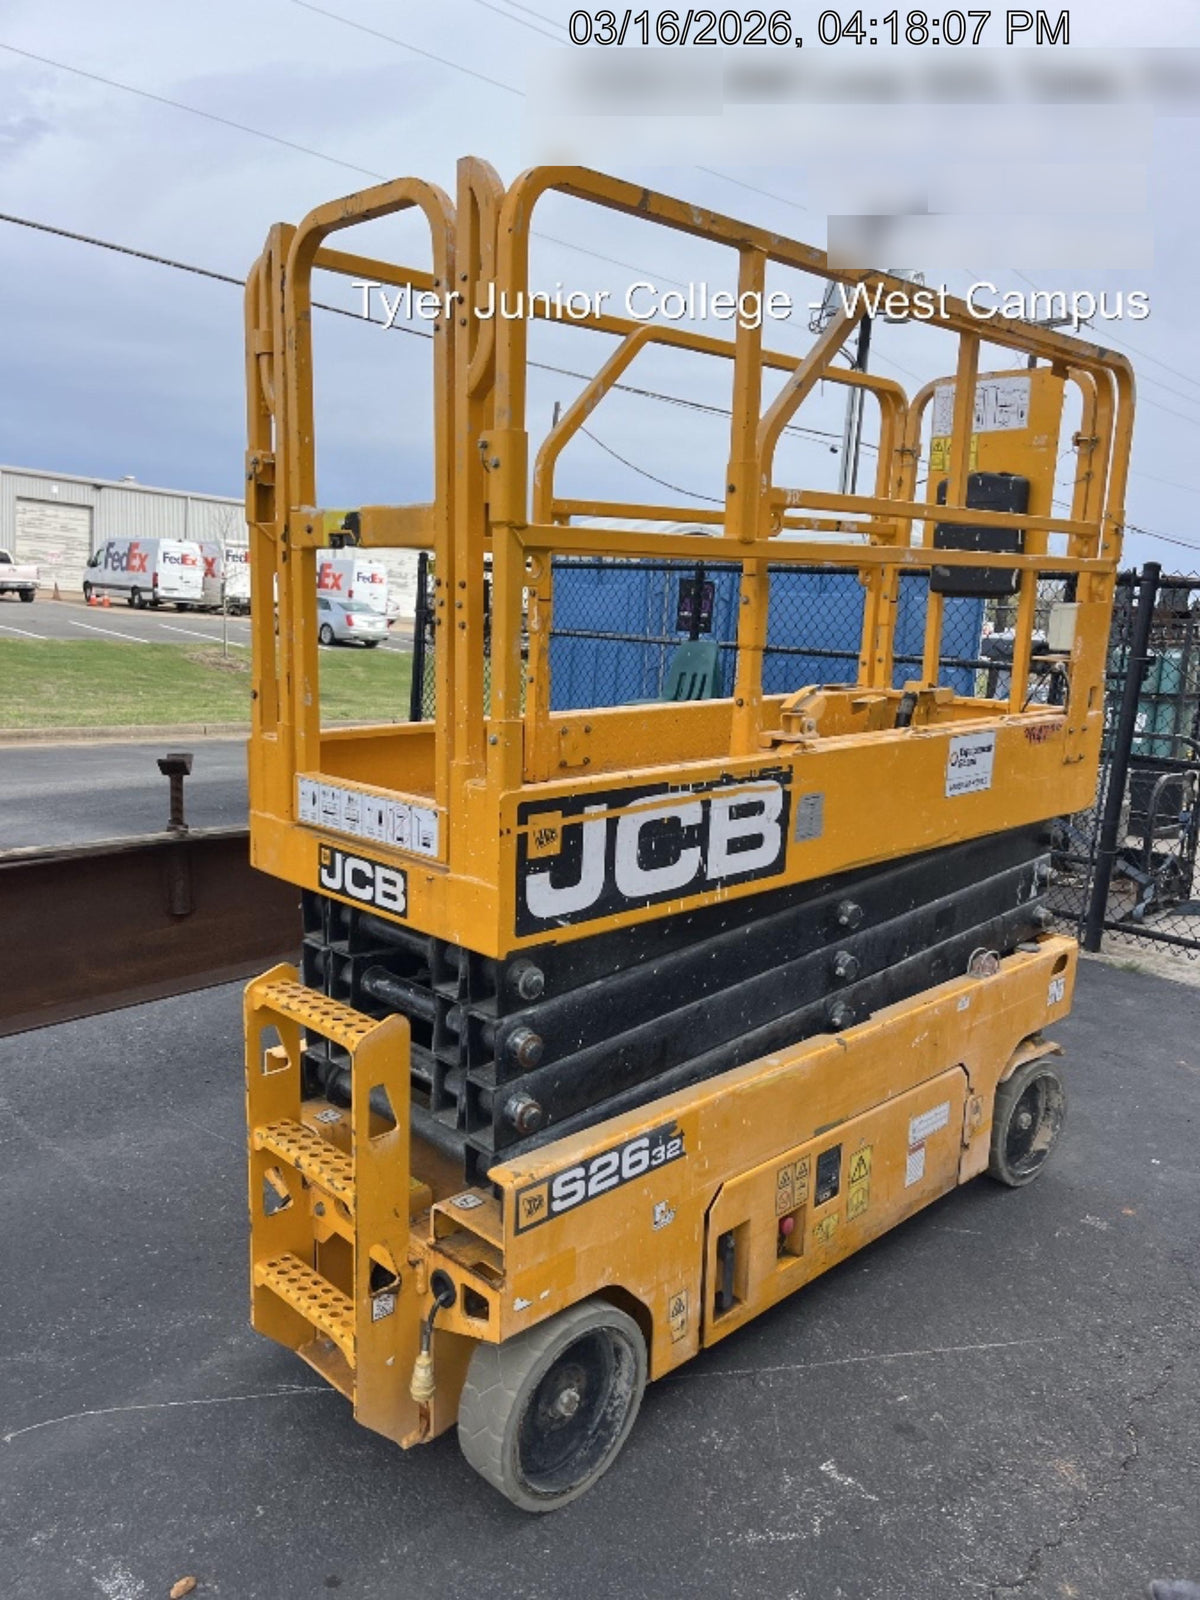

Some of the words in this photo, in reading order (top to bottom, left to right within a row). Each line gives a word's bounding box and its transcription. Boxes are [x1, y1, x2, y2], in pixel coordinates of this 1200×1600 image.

[104, 542, 149, 573] FedEx
[163, 551, 198, 566] FedEx
[357, 571, 384, 584] FedEx
[525, 779, 784, 918] JCB
[321, 852, 407, 913] JCB
